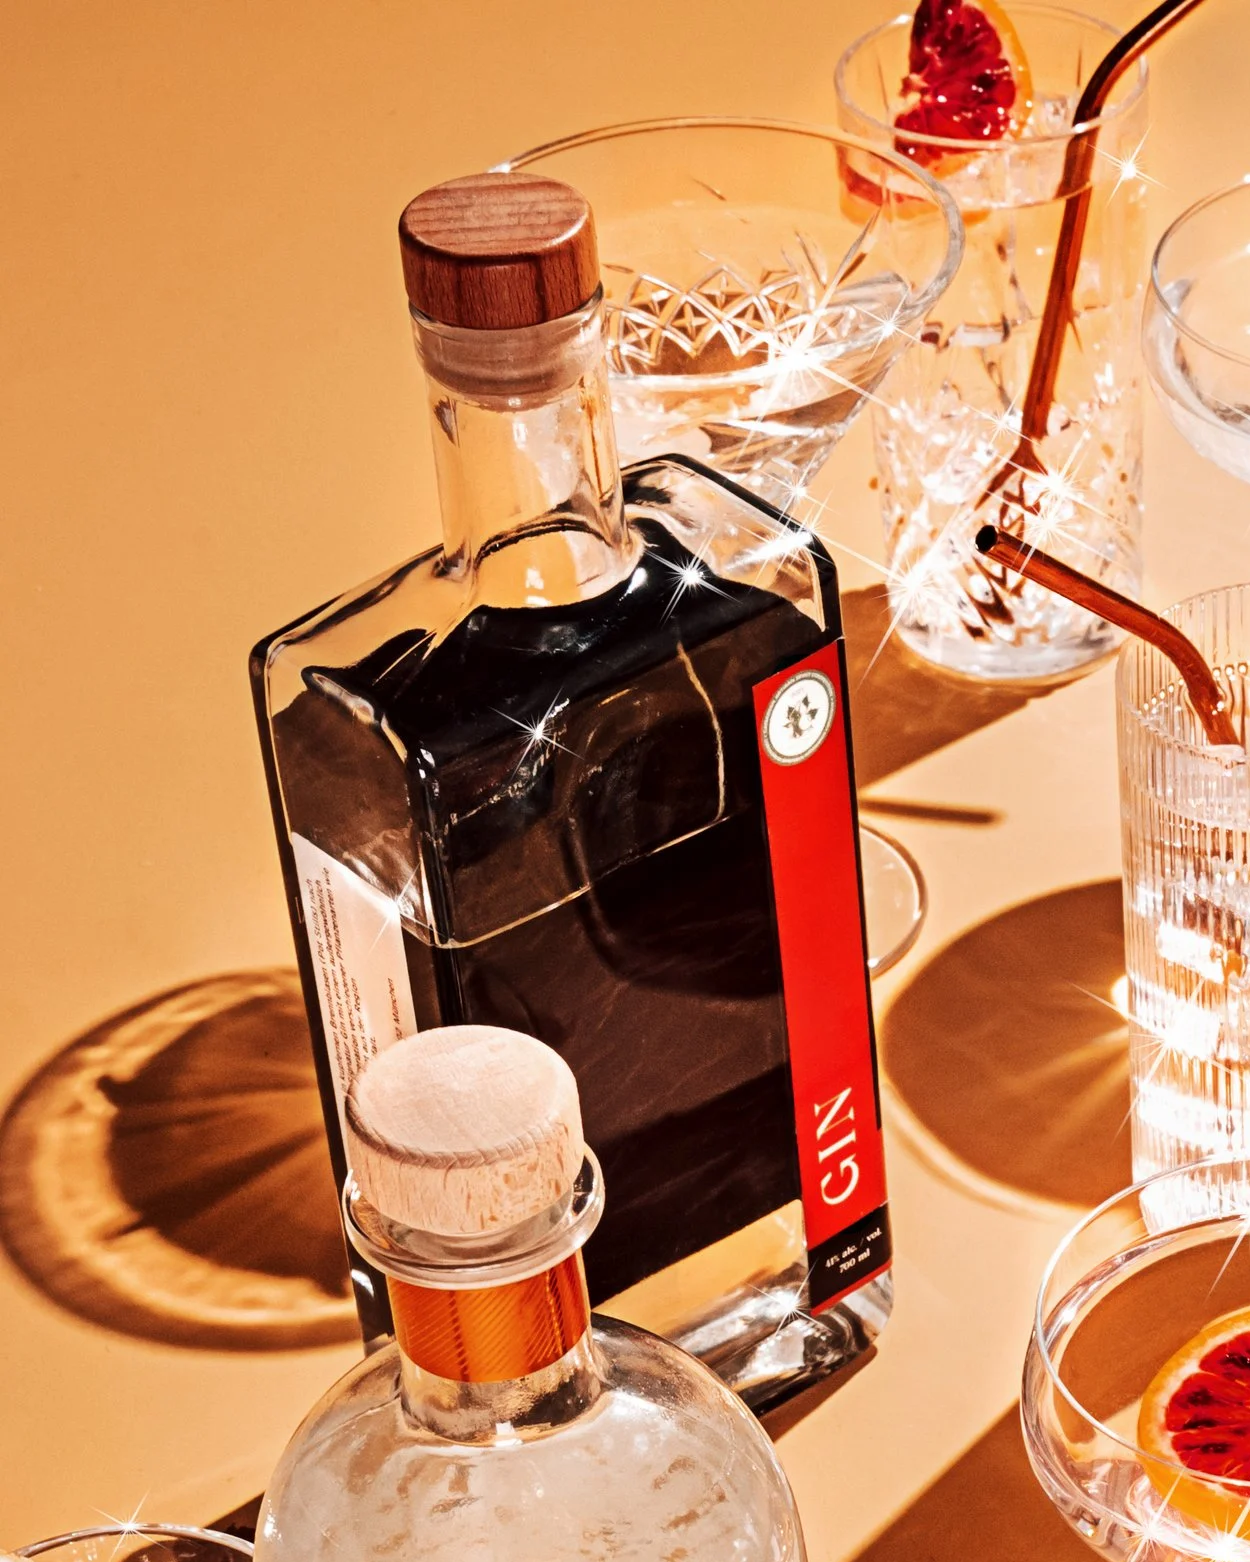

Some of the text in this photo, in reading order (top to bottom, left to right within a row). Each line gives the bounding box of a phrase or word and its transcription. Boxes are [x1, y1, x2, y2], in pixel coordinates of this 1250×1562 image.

[814, 1087, 859, 1205] GIN
[839, 1248, 870, 1274] 700 ml
